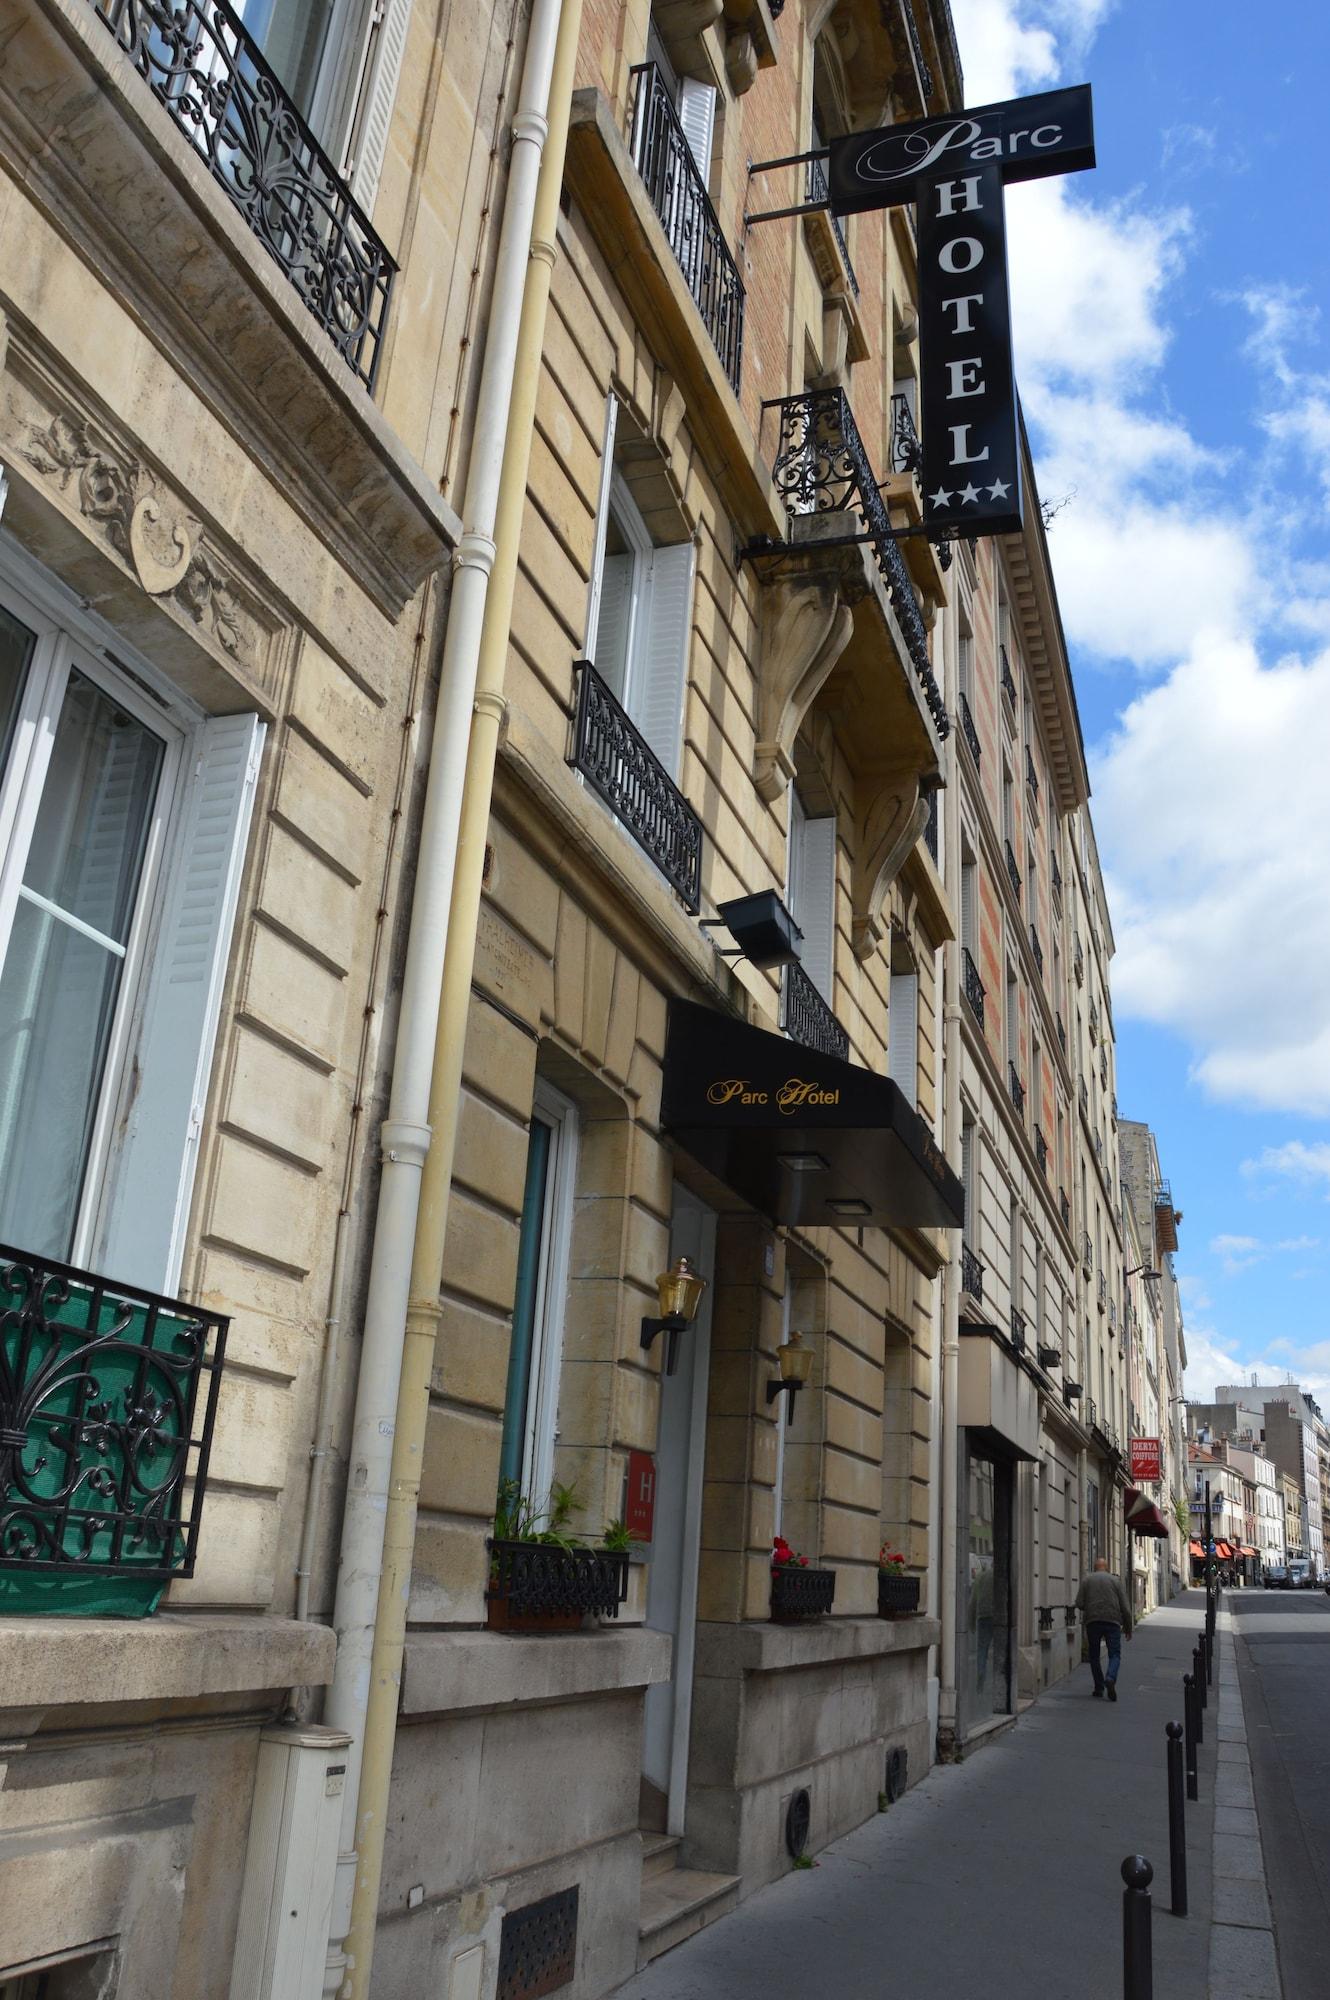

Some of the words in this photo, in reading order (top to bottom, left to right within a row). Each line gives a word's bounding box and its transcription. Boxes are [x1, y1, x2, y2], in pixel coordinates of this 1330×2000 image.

[855, 112, 1063, 181] Parc
[935, 175, 989, 466] HOTEL
[707, 1079, 768, 1105] Parc
[775, 1078, 840, 1115] Hotel
[1132, 1451, 1159, 1461] COIFFURE
[1133, 1442, 1158, 1451] DERYA
[640, 1471, 652, 1503] H
